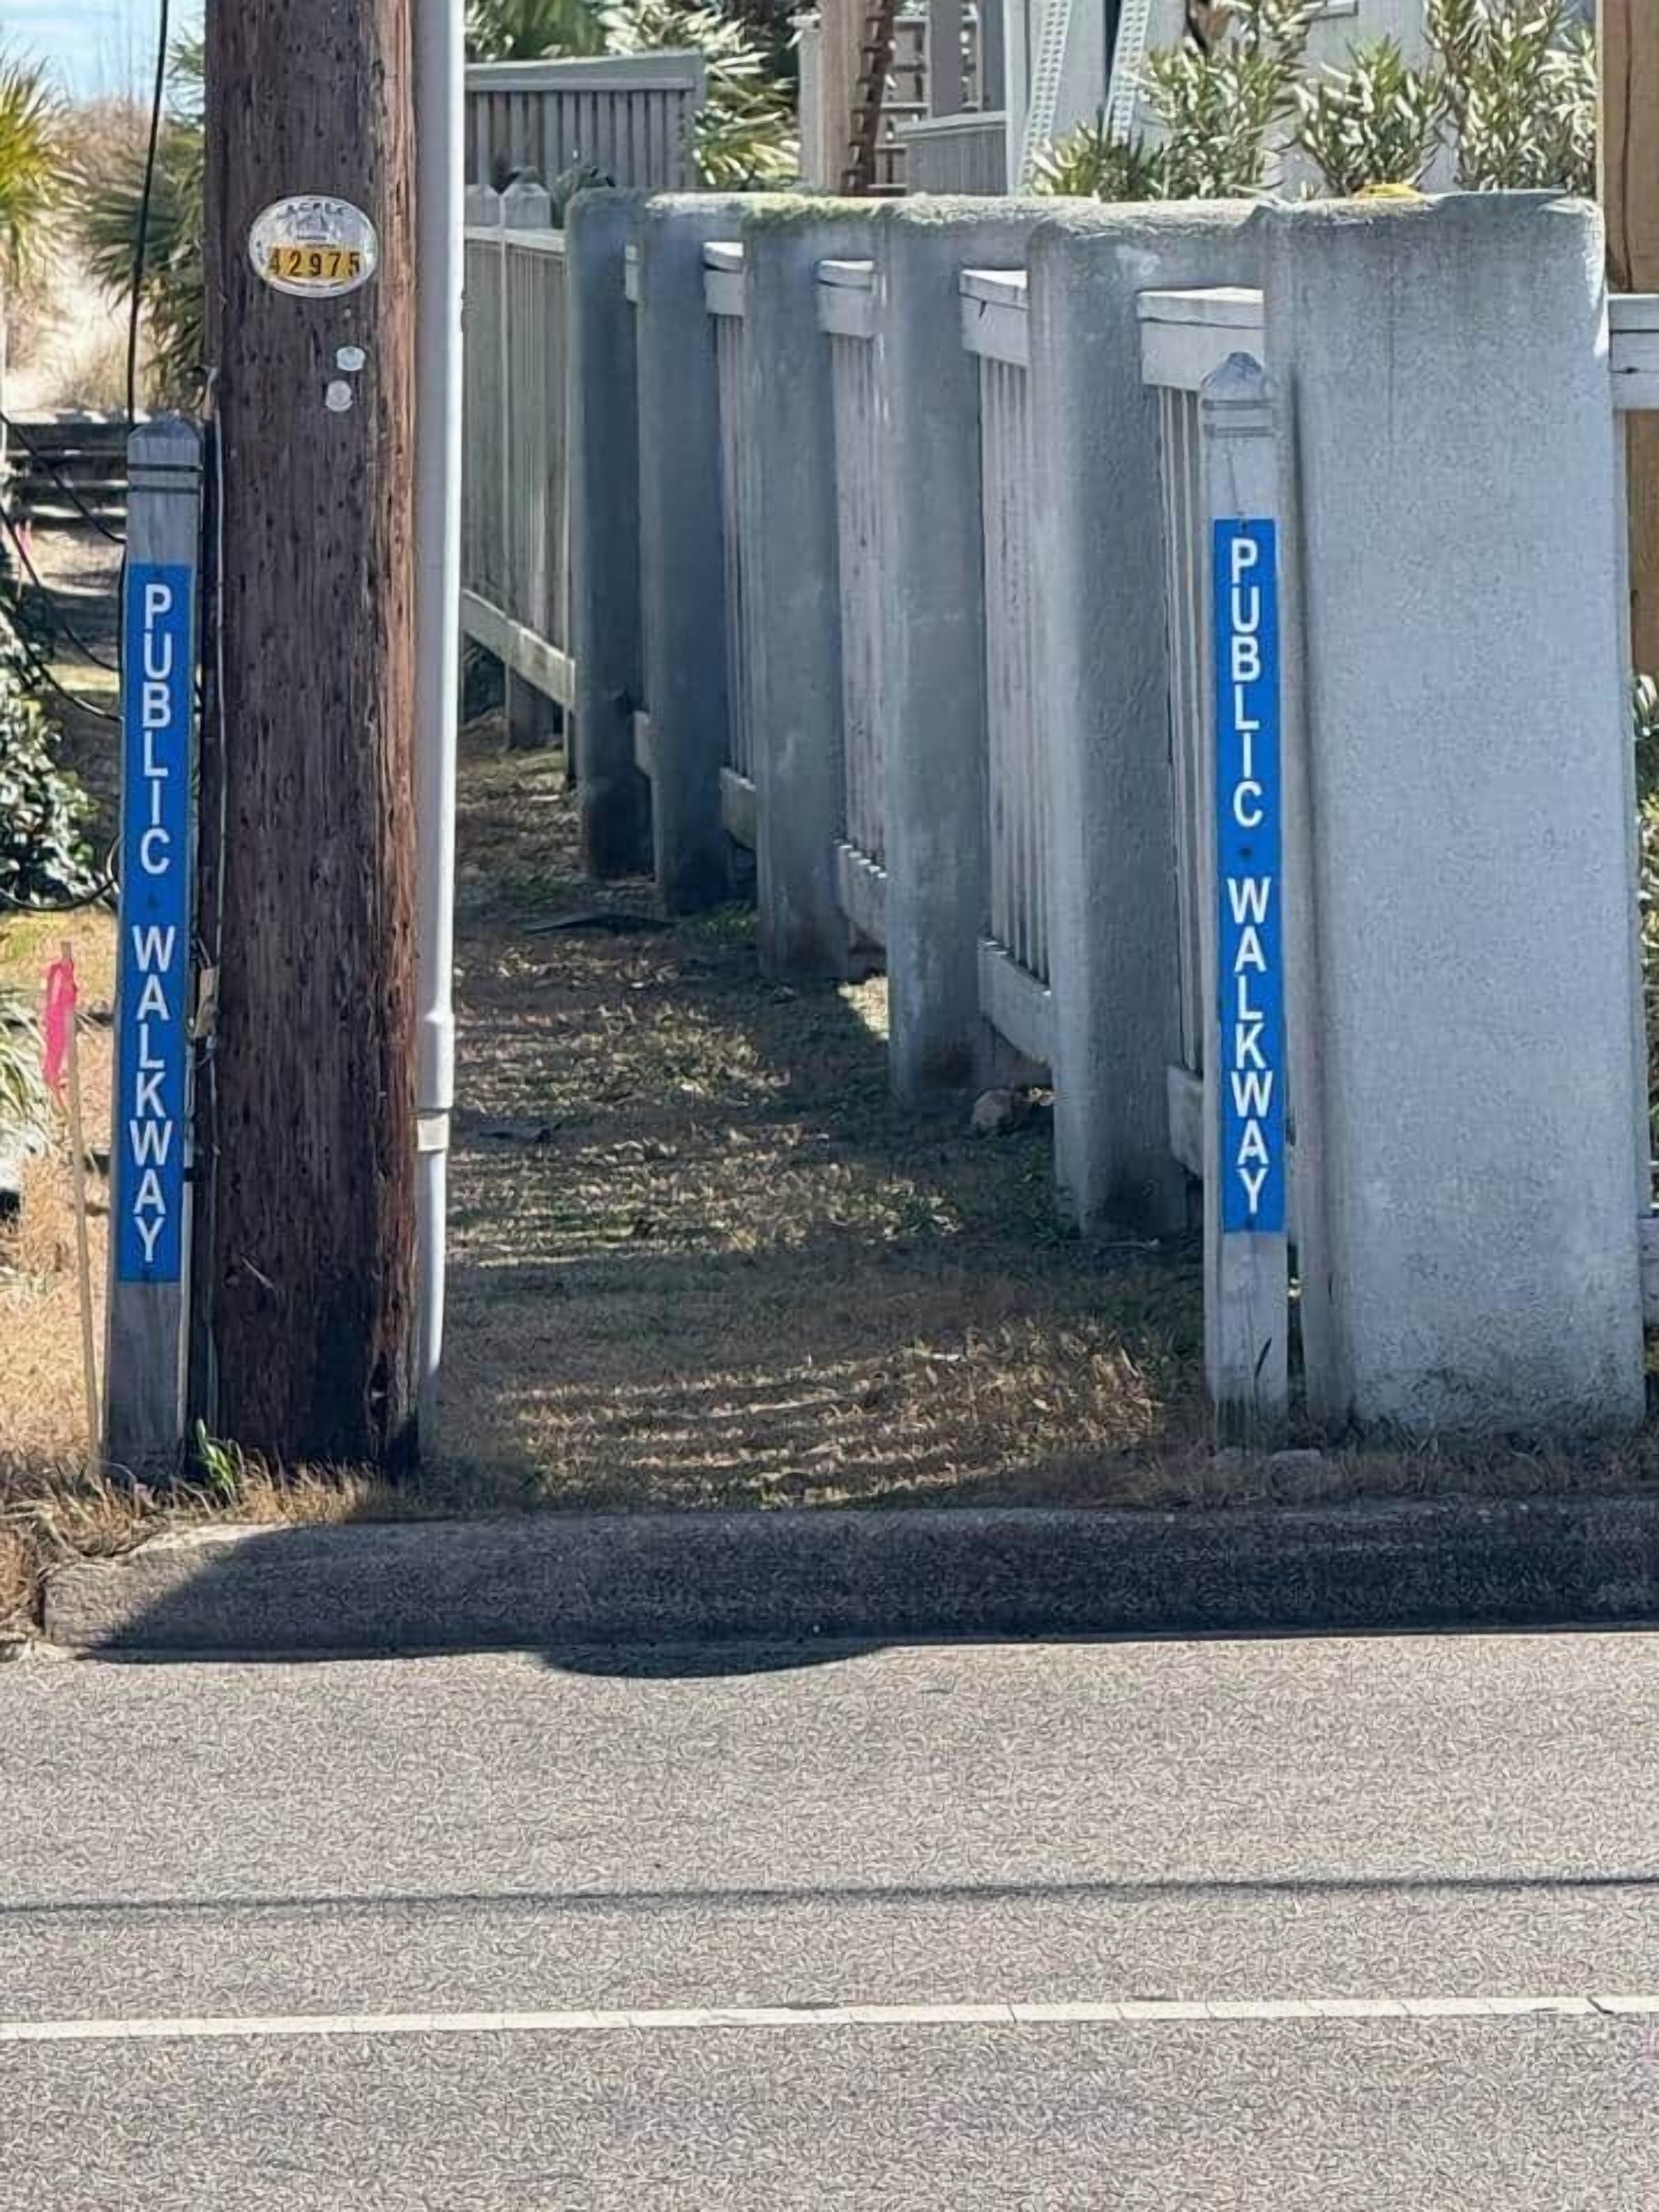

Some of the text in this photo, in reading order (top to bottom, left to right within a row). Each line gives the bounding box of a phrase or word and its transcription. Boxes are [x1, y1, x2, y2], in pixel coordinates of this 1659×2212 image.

[268, 248, 361, 277] 42975
[129, 584, 175, 1262] PUBLIC WALKWAY
[1227, 537, 1273, 1214] PUBLIC WALKWAY
